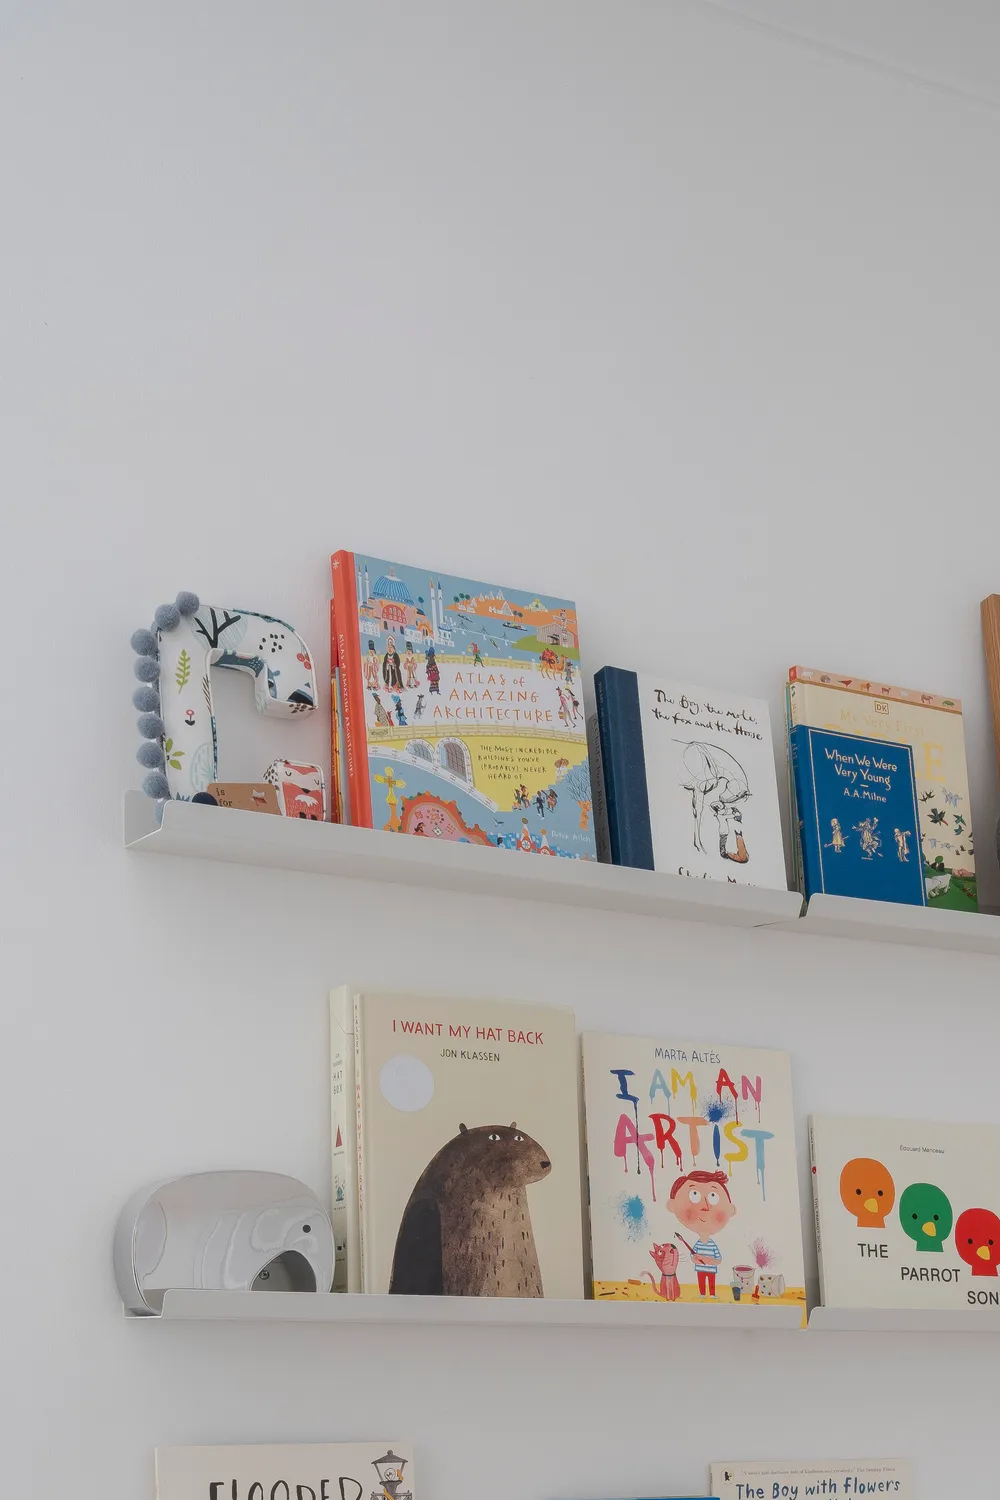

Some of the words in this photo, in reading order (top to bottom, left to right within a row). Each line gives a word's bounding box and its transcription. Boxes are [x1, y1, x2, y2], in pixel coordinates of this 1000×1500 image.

[455, 671, 507, 685] ATLAS
[513, 677, 525, 687] of
[449, 688, 539, 703] AMAZING
[654, 689, 674, 704] The
[704, 703, 723, 715] the
[433, 705, 553, 723] ARCHITECTURE
[876, 703, 888, 712] DK
[651, 708, 670, 720] the
[672, 712, 692, 724] fox
[695, 721, 713, 730] and
[715, 720, 732, 733] the
[863, 716, 892, 731] Very
[516, 747, 558, 755] INCREDIBLE
[481, 764, 519, 772] (PROBABLY)
[824, 748, 854, 764] When
[854, 754, 871, 767] We
[872, 757, 898, 772] Were
[834, 764, 858, 784] Very
[860, 769, 891, 791] Young
[215, 788, 225, 796] is
[392, 1020, 396, 1032] I
[401, 1021, 443, 1037] WANT
[449, 1025, 471, 1039] MY
[476, 1027, 502, 1041] HAT
[508, 1030, 544, 1045] BACK
[440, 1049, 457, 1059] JON
[461, 1050, 500, 1062] KLASSEN
[654, 1047, 688, 1062] MARTA
[692, 1050, 721, 1064] ALTÉS
[649, 1067, 697, 1104] AM
[714, 1068, 762, 1106] AN
[613, 1113, 775, 1176] ARTIST
[857, 1243, 889, 1259] THE
[900, 1267, 960, 1283] PARROT
[736, 1484, 764, 1500] The
[772, 1482, 798, 1500] Boy
[805, 1478, 836, 1496] with
